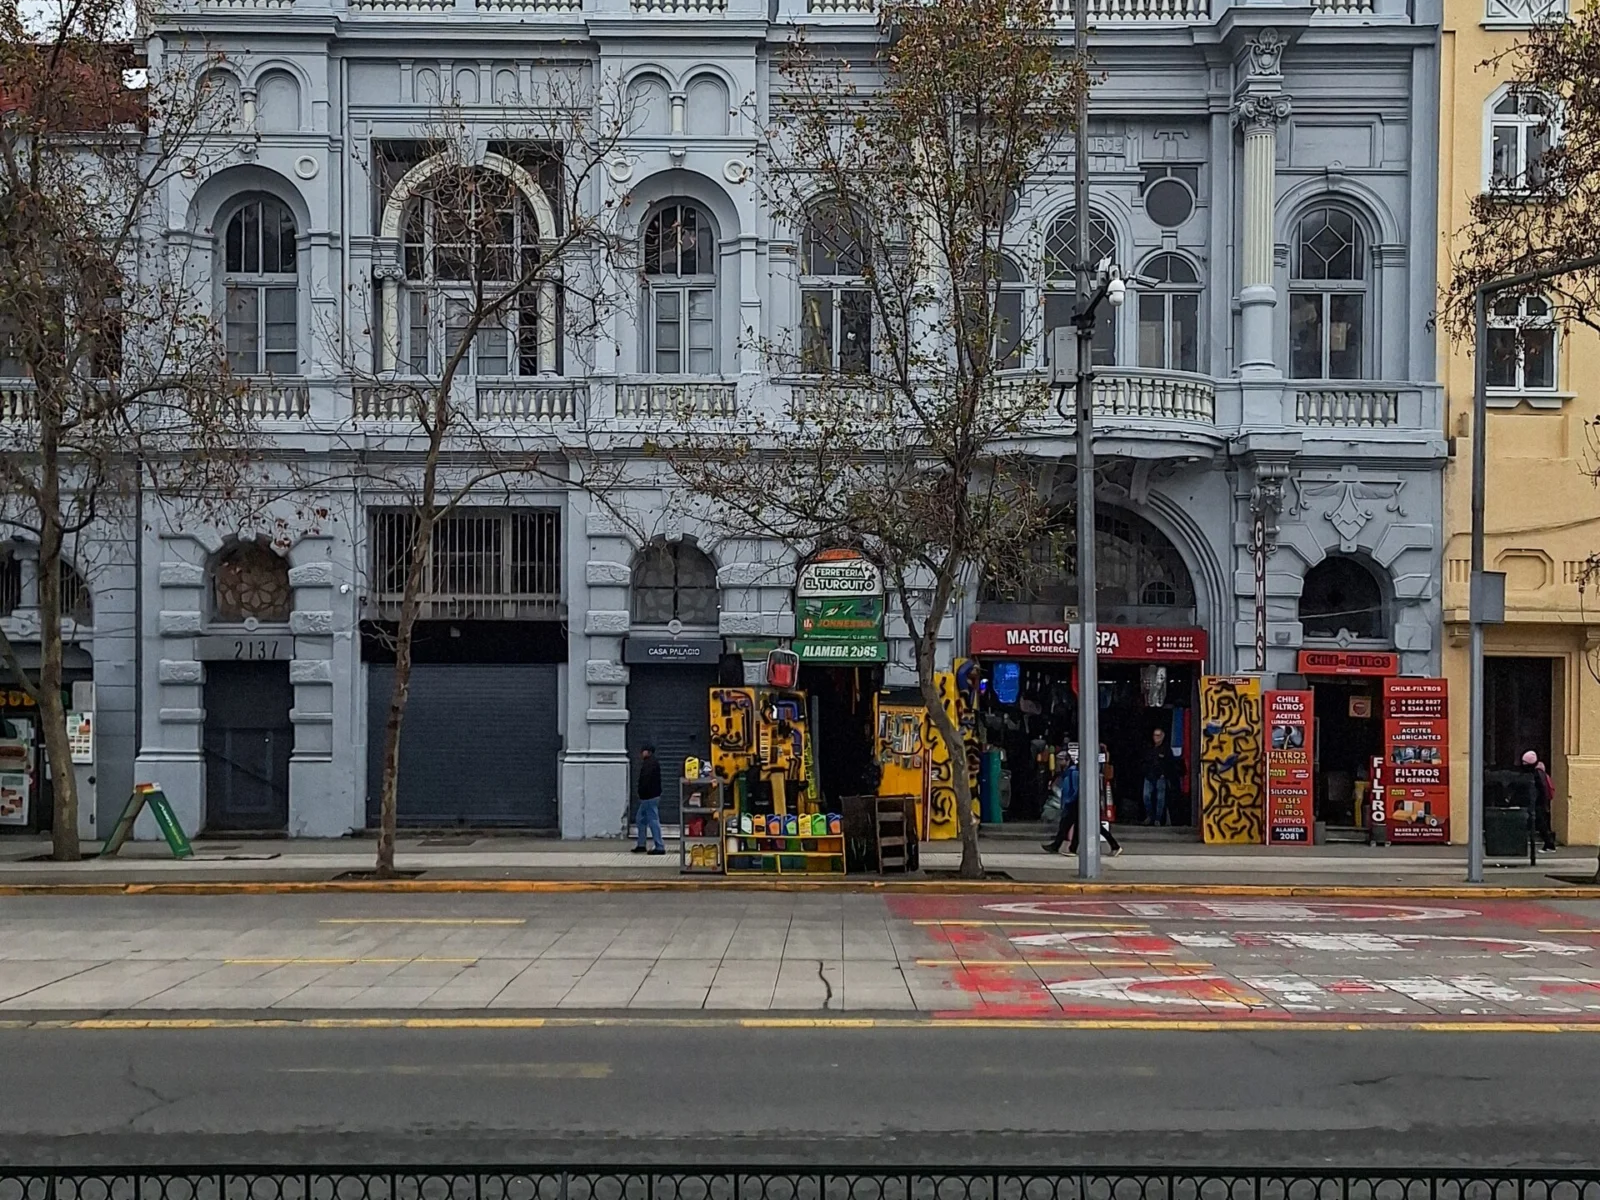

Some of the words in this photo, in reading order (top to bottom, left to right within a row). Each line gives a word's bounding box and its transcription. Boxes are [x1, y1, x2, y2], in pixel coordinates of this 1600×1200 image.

[805, 579, 817, 589] EL
[819, 579, 875, 591] TURQUITO
[1255, 520, 1265, 667] GOMAS
[234, 640, 279, 660] 2137
[803, 645, 849, 657] ALAMEDA
[1272, 703, 1305, 711] FILTROS
[1271, 751, 1307, 759] FILTROS
[1395, 768, 1440, 776] FILTROS
[1371, 757, 1386, 822] FILTRO
